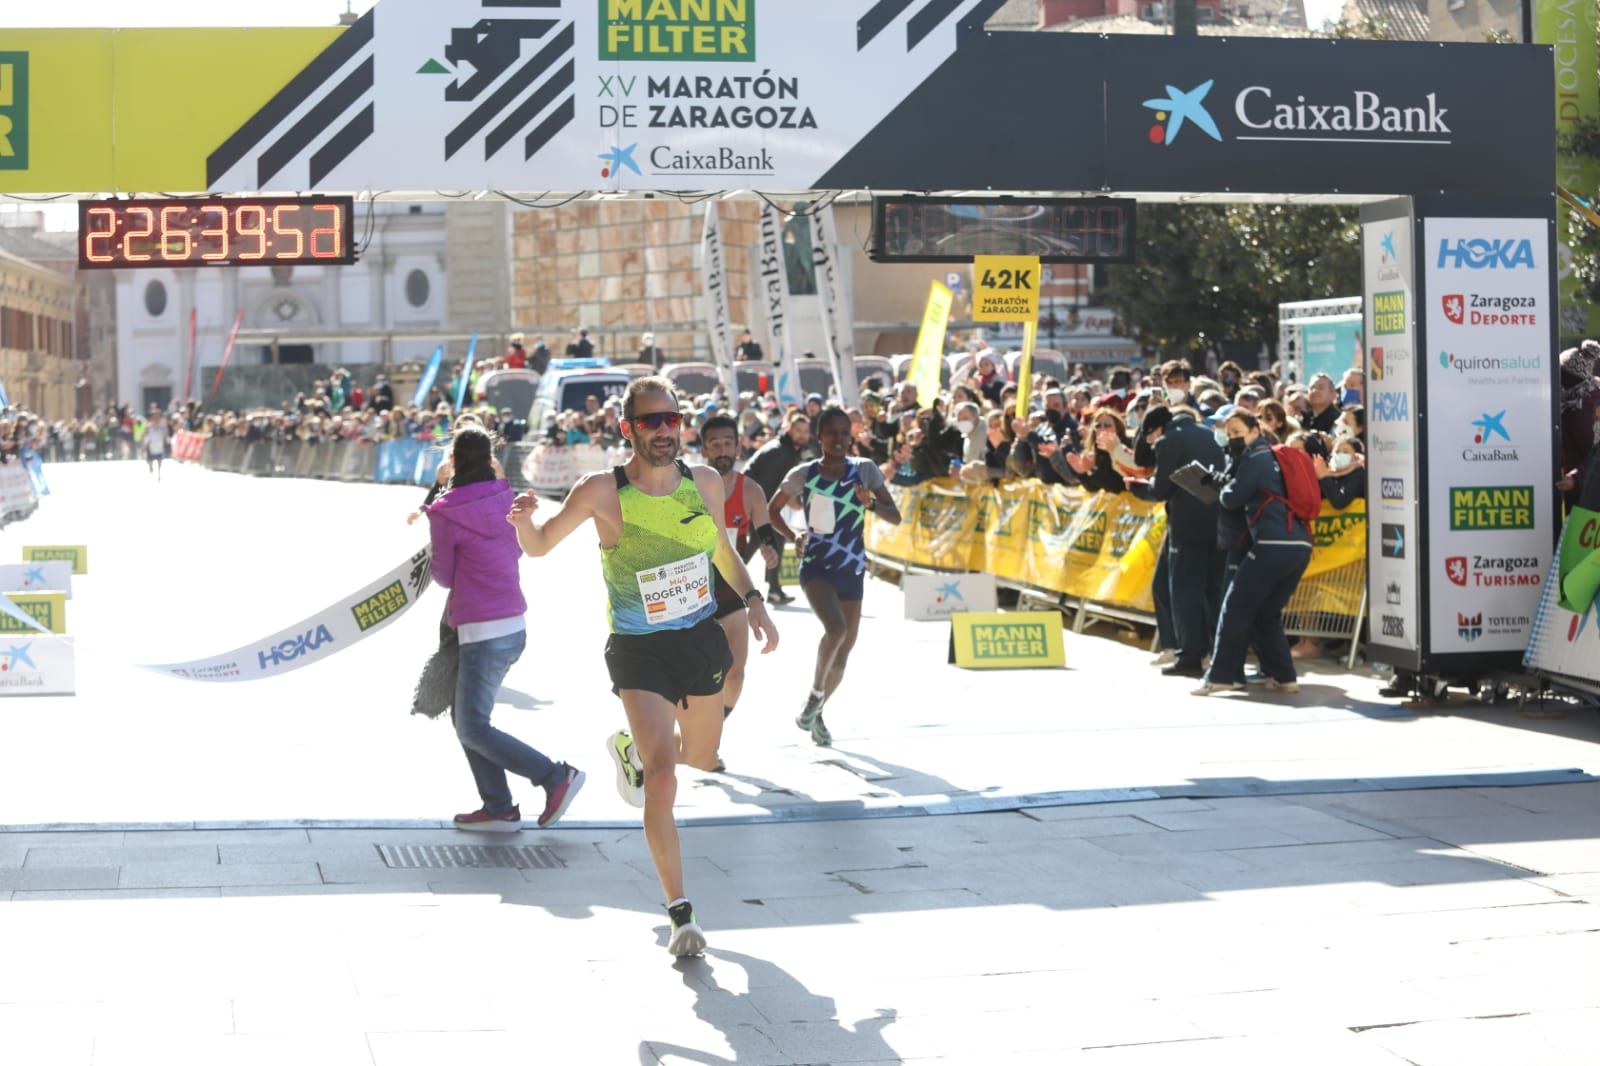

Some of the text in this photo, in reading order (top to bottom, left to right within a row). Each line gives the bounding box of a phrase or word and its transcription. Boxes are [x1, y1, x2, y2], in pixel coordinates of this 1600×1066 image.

[608, 0, 746, 22] MANN
[607, 25, 748, 54] FILTER
[597, 69, 798, 100] XV MARATÓN
[599, 105, 818, 129] DE ZARAGOZA
[1234, 86, 1452, 133] CaixaBank
[650, 146, 775, 170] CaixaBank
[1438, 238, 1536, 270] HOKA
[981, 269, 1032, 290] 42K
[981, 306, 1030, 314] ZARAGOZA
[984, 296, 1029, 305] MARATÓN
[1375, 294, 1404, 313] MANN
[1470, 294, 1536, 311] Zaragoza
[1375, 312, 1405, 332] FILTER
[1471, 311, 1536, 325] DEPORTE
[1372, 391, 1408, 421] HOKA
[1462, 449, 1519, 461] CaixaBank
[1454, 489, 1530, 508] MANN
[1454, 508, 1530, 526] FILTER
[1474, 556, 1538, 572] Zaragoza
[644, 576, 708, 602] ROGER ROCA
[1473, 572, 1540, 586] TURISMO
[354, 583, 402, 617] MANN
[679, 597, 688, 605] 19
[360, 594, 405, 629] FILTER
[975, 626, 1042, 641] MANN
[257, 624, 335, 670] HOKA
[976, 641, 1044, 656] FILTER
